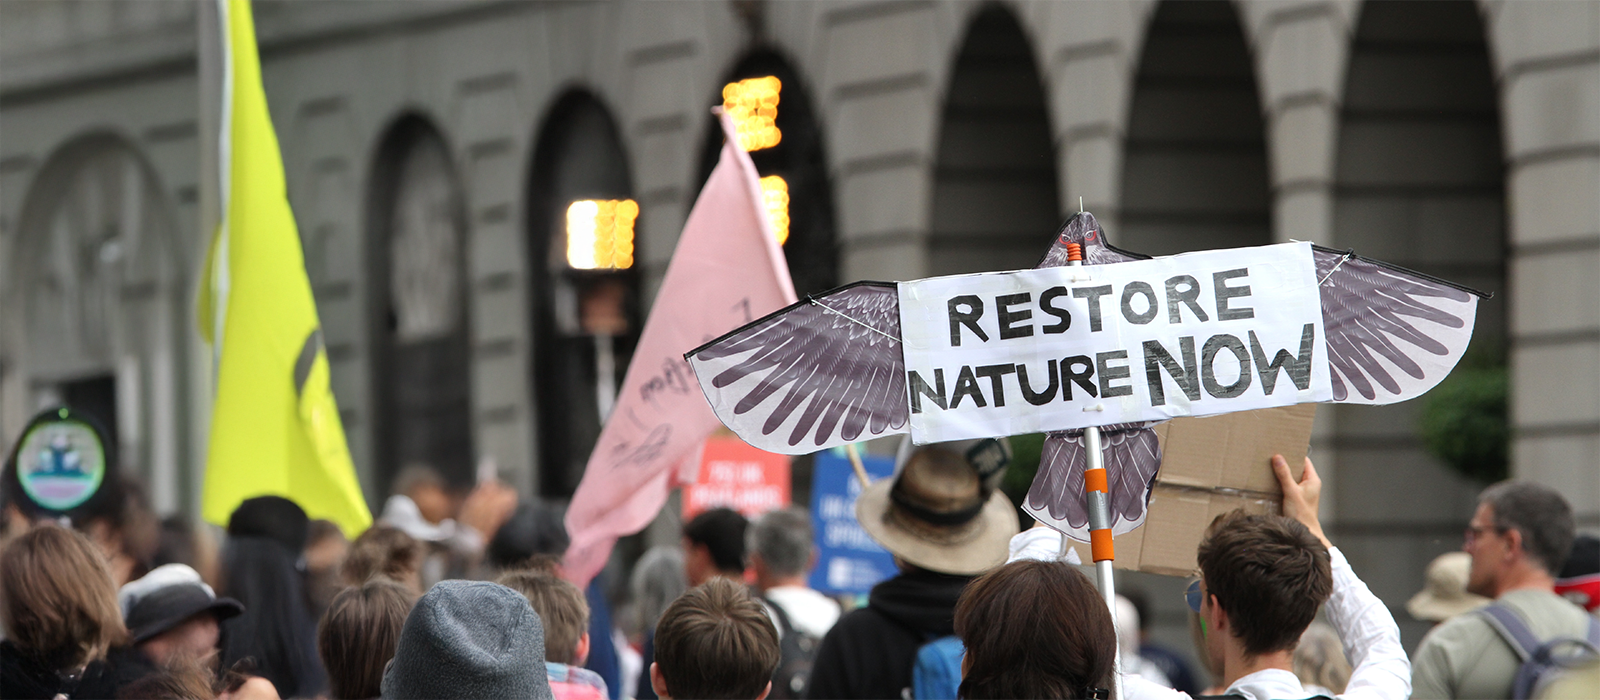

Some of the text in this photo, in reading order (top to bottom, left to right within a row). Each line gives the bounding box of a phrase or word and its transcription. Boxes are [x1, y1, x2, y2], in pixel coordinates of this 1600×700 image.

[947, 267, 1255, 347] RESTORE
[907, 323, 1315, 414] NATURE NOW
